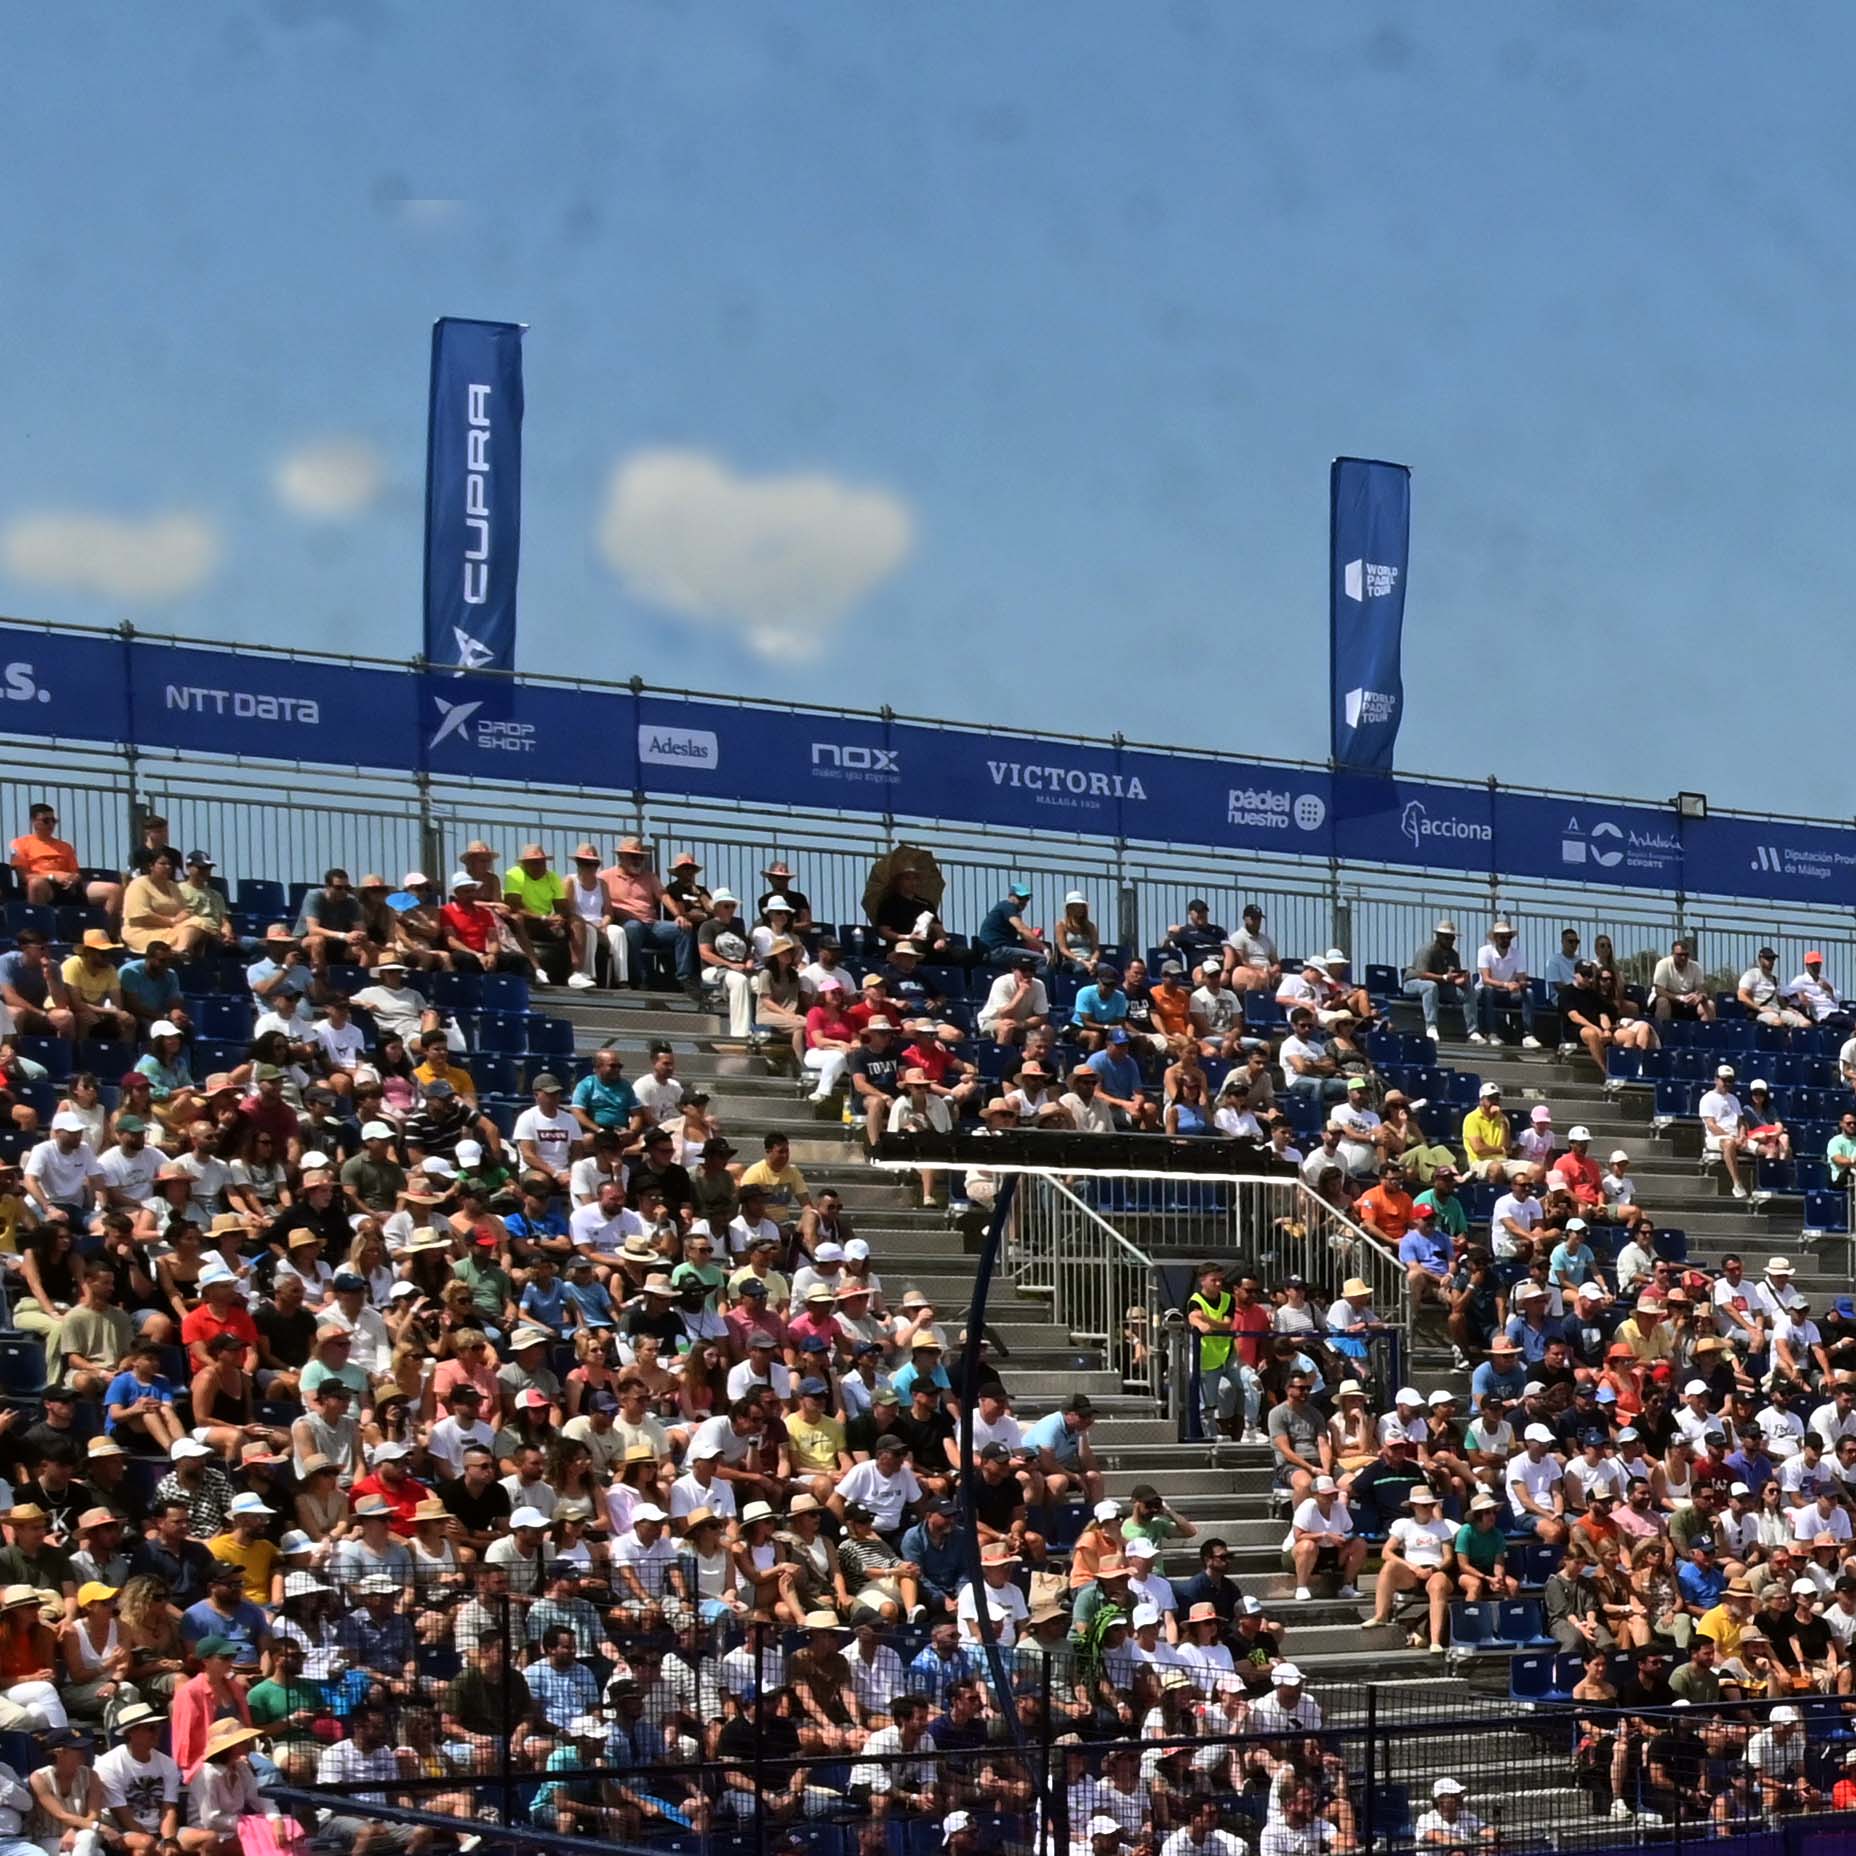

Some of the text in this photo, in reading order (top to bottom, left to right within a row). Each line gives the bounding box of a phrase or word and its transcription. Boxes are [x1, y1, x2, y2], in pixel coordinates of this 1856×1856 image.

[464, 384, 491, 603] CUPRA
[166, 685, 229, 714] NTT
[478, 720, 535, 736] DROP
[478, 736, 536, 751] SHOT
[649, 737, 708, 759] Adeslas
[987, 760, 1147, 800] VICTORIA
[1228, 788, 1290, 815] pádel
[1228, 810, 1288, 829] nuestro
[1421, 819, 1491, 840] acciona
[1784, 848, 1834, 866] Diputación
[1785, 863, 1831, 879] de Málaga
